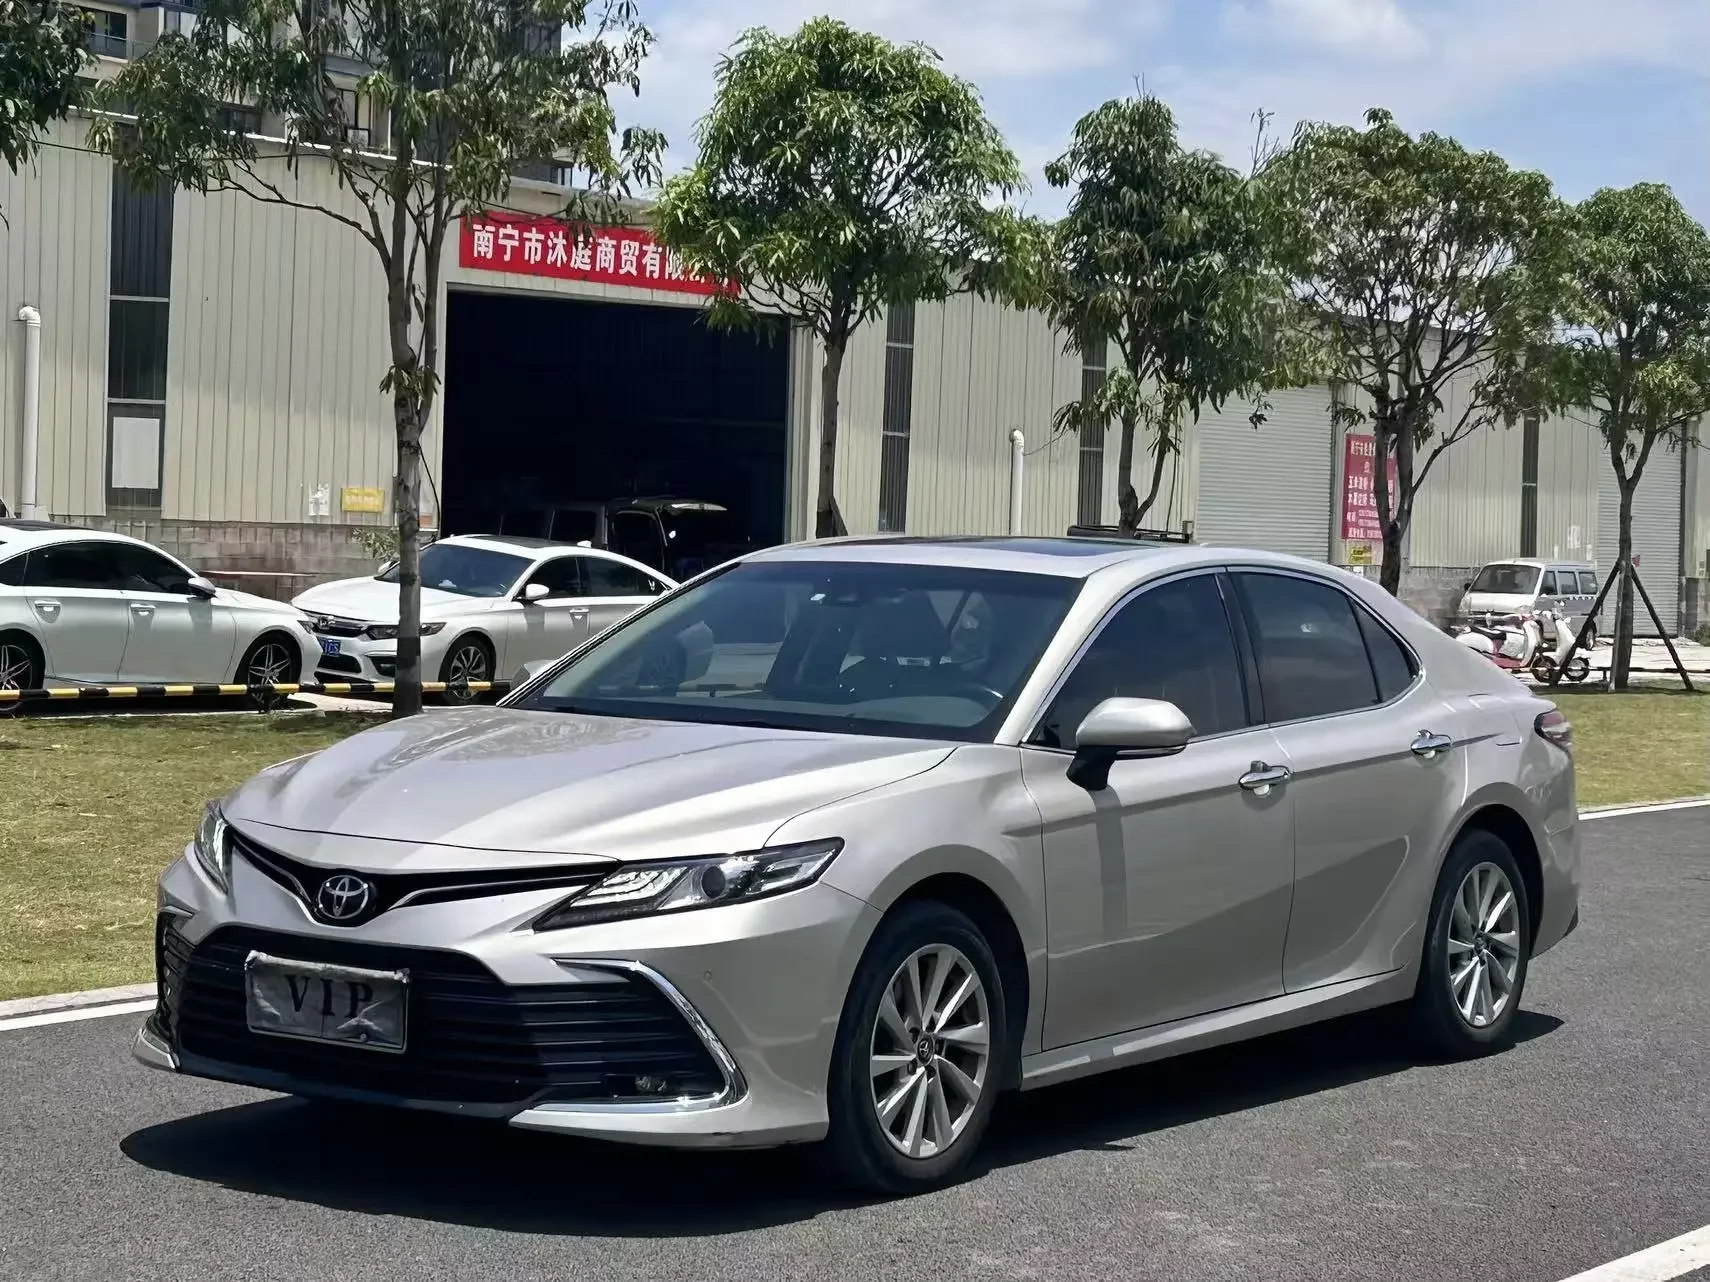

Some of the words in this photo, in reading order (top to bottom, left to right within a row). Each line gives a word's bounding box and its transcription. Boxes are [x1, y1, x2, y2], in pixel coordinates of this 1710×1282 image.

[472, 223, 730, 288] 南宁市沐庭商贸有限
[284, 974, 374, 1019] VIP
